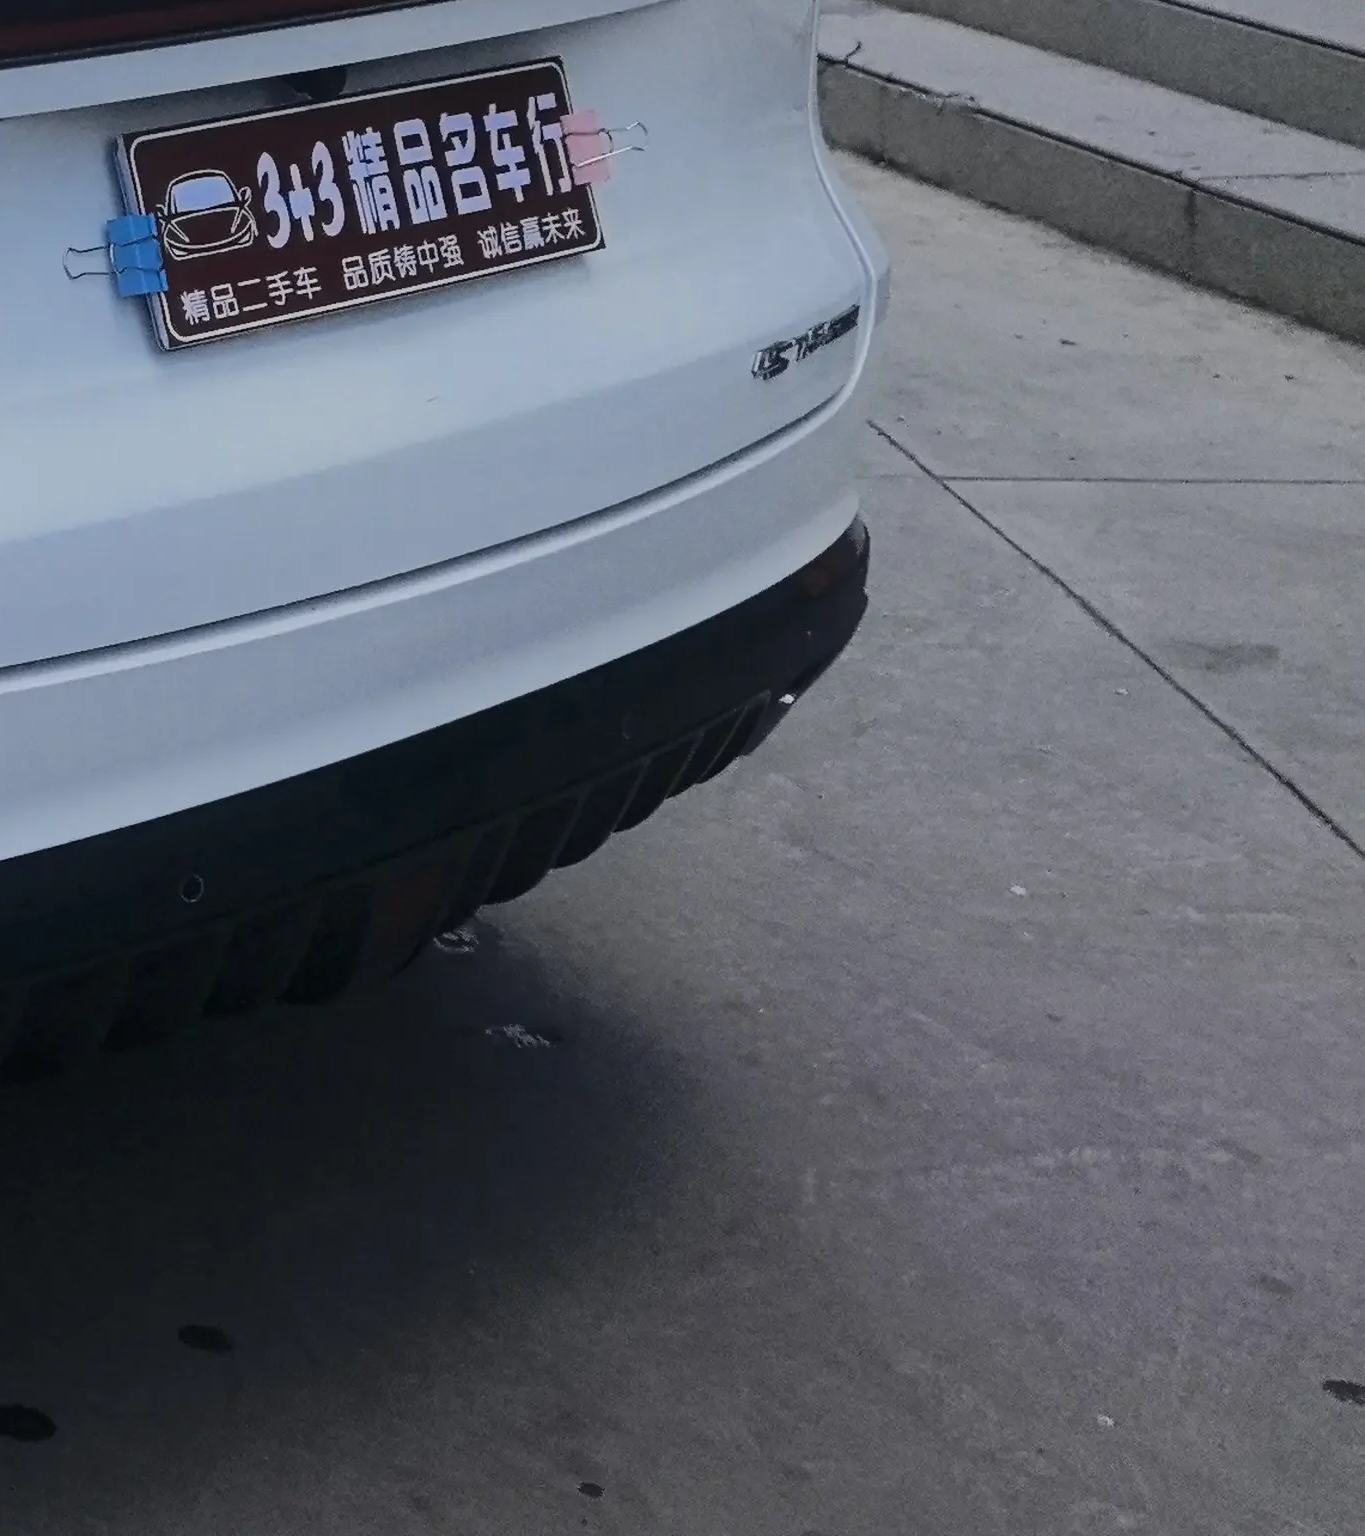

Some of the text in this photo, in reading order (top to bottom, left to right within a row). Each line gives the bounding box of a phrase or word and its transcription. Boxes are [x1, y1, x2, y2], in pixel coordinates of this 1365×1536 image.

[180, 266, 322, 327] 精品二手车
[477, 207, 587, 262] 诚信赢未来
